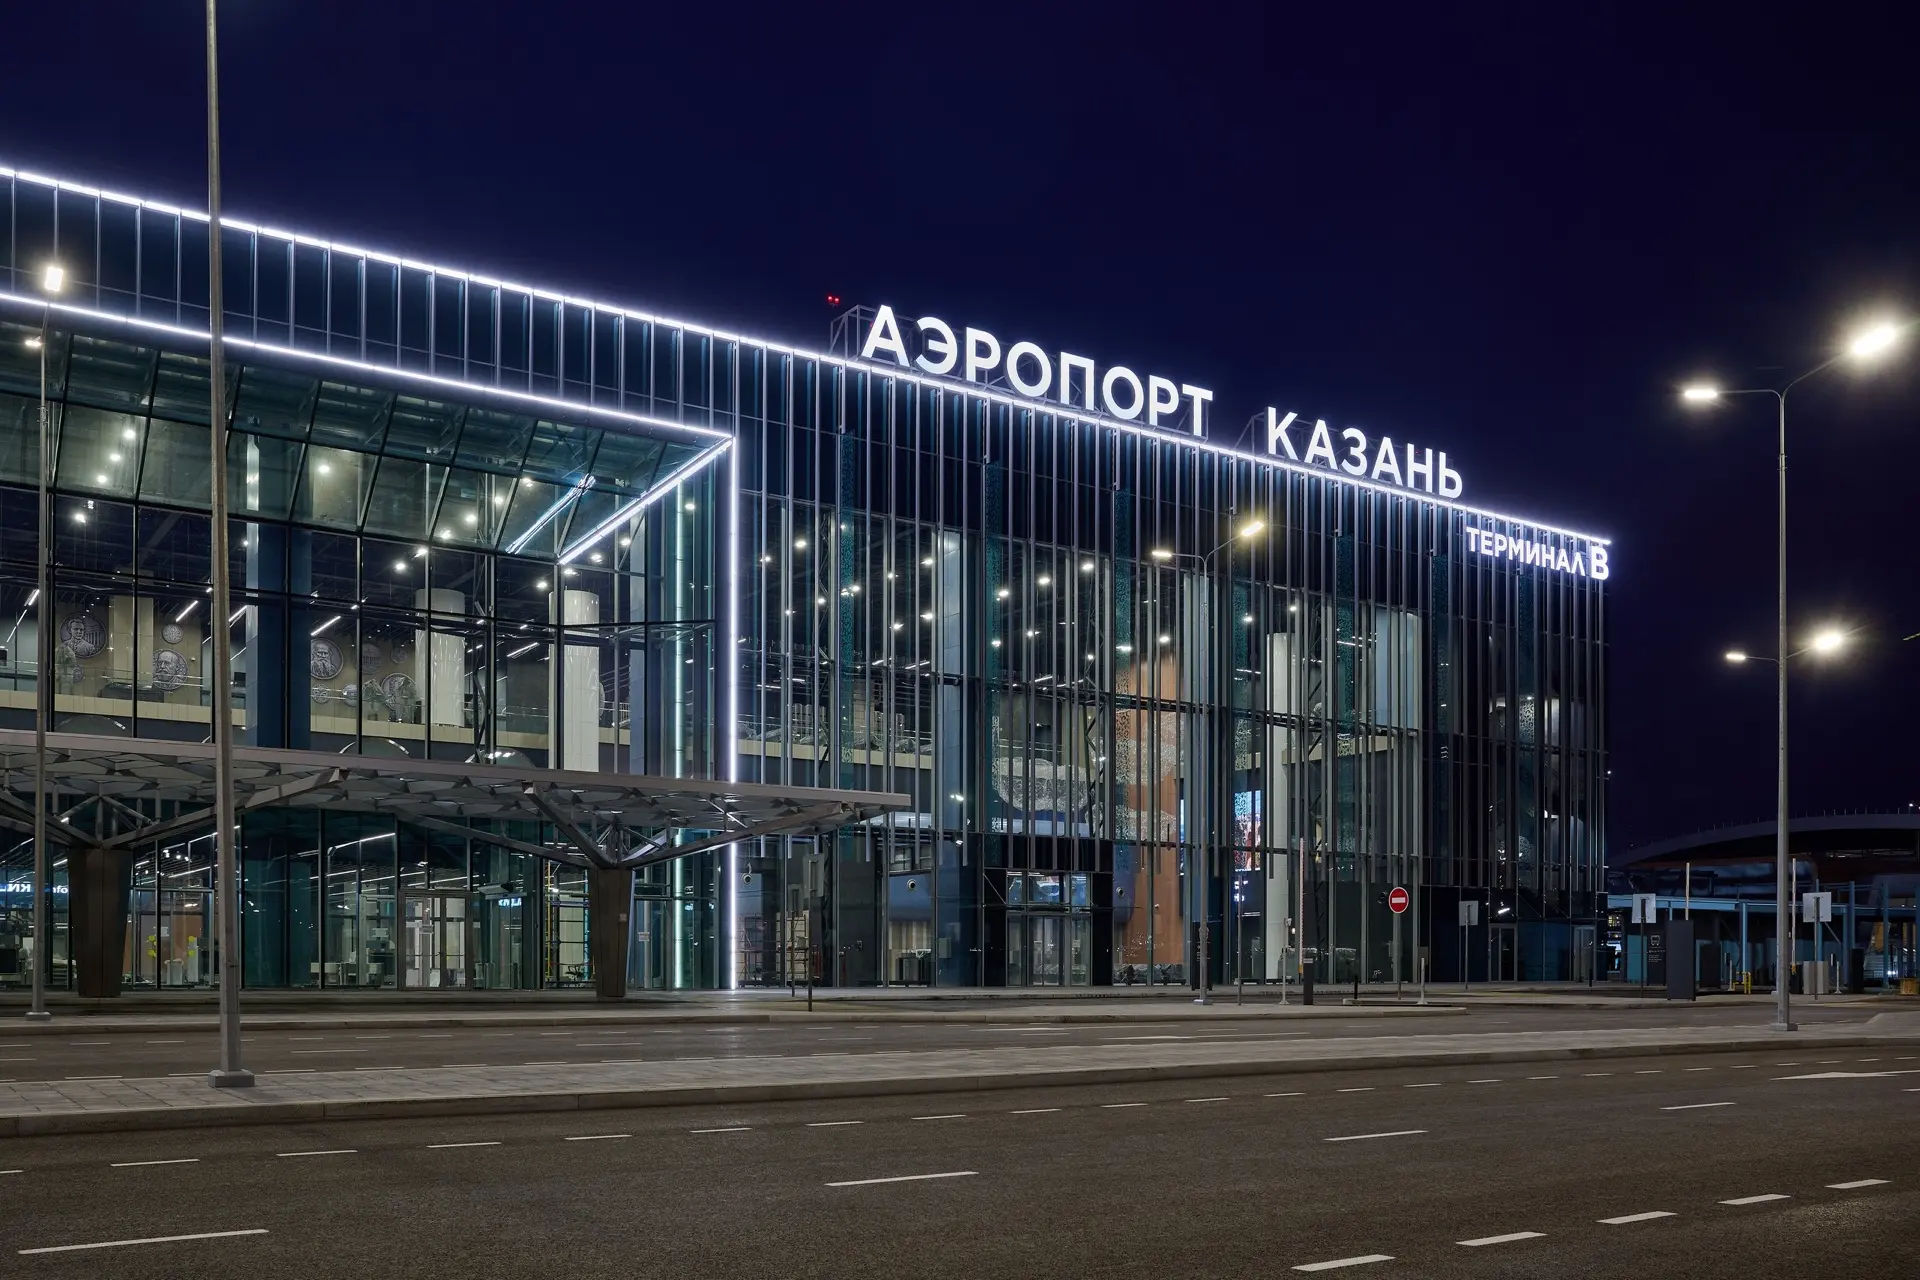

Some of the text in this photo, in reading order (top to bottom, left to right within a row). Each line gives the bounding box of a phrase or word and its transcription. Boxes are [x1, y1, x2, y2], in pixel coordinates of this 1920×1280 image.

[861, 304, 1463, 499] АЭРОПОРТ КАЗАНЬ
[1465, 527, 1586, 577] ТЕРМИНАЛ
